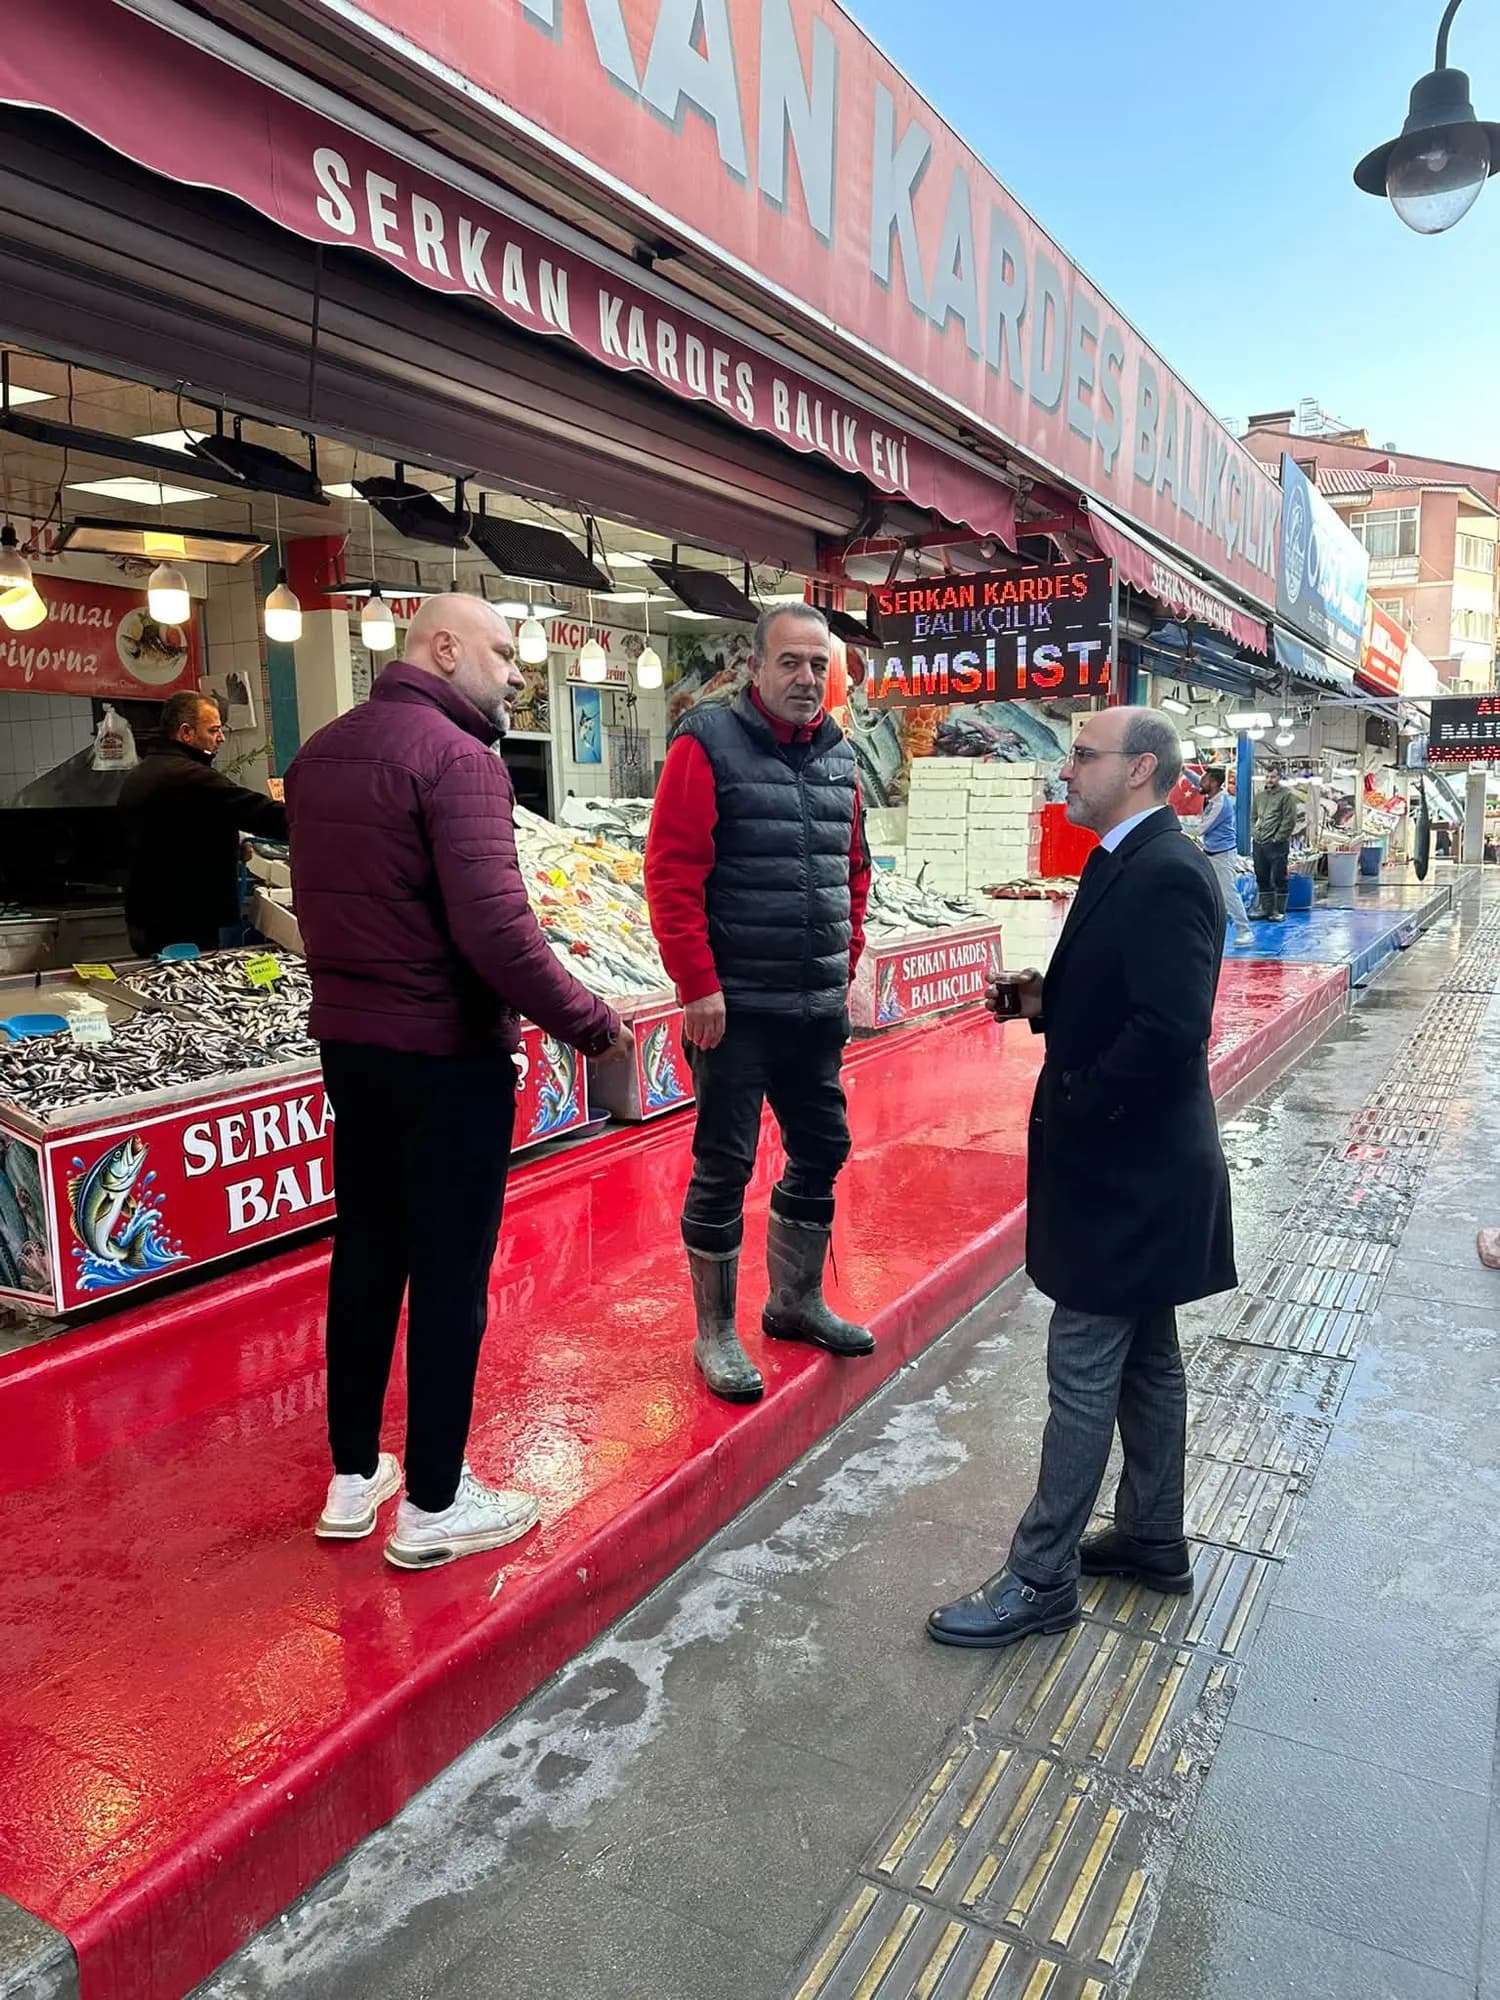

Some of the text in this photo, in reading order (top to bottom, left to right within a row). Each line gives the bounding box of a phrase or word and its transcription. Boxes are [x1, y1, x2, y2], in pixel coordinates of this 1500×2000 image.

[312, 147, 911, 491] SERKAN KARDEŞ BALIK EVİ
[870, 80, 1126, 478] KARDEŞ
[1133, 356, 1280, 582] BALIKÇILIK
[879, 572, 1089, 616] SERKAN KARDEŞ
[915, 602, 1054, 637] BALIKÇILIK
[902, 941, 988, 981] SERKAN KARDEŞ
[911, 970, 984, 1009] BALIKÇILIK
